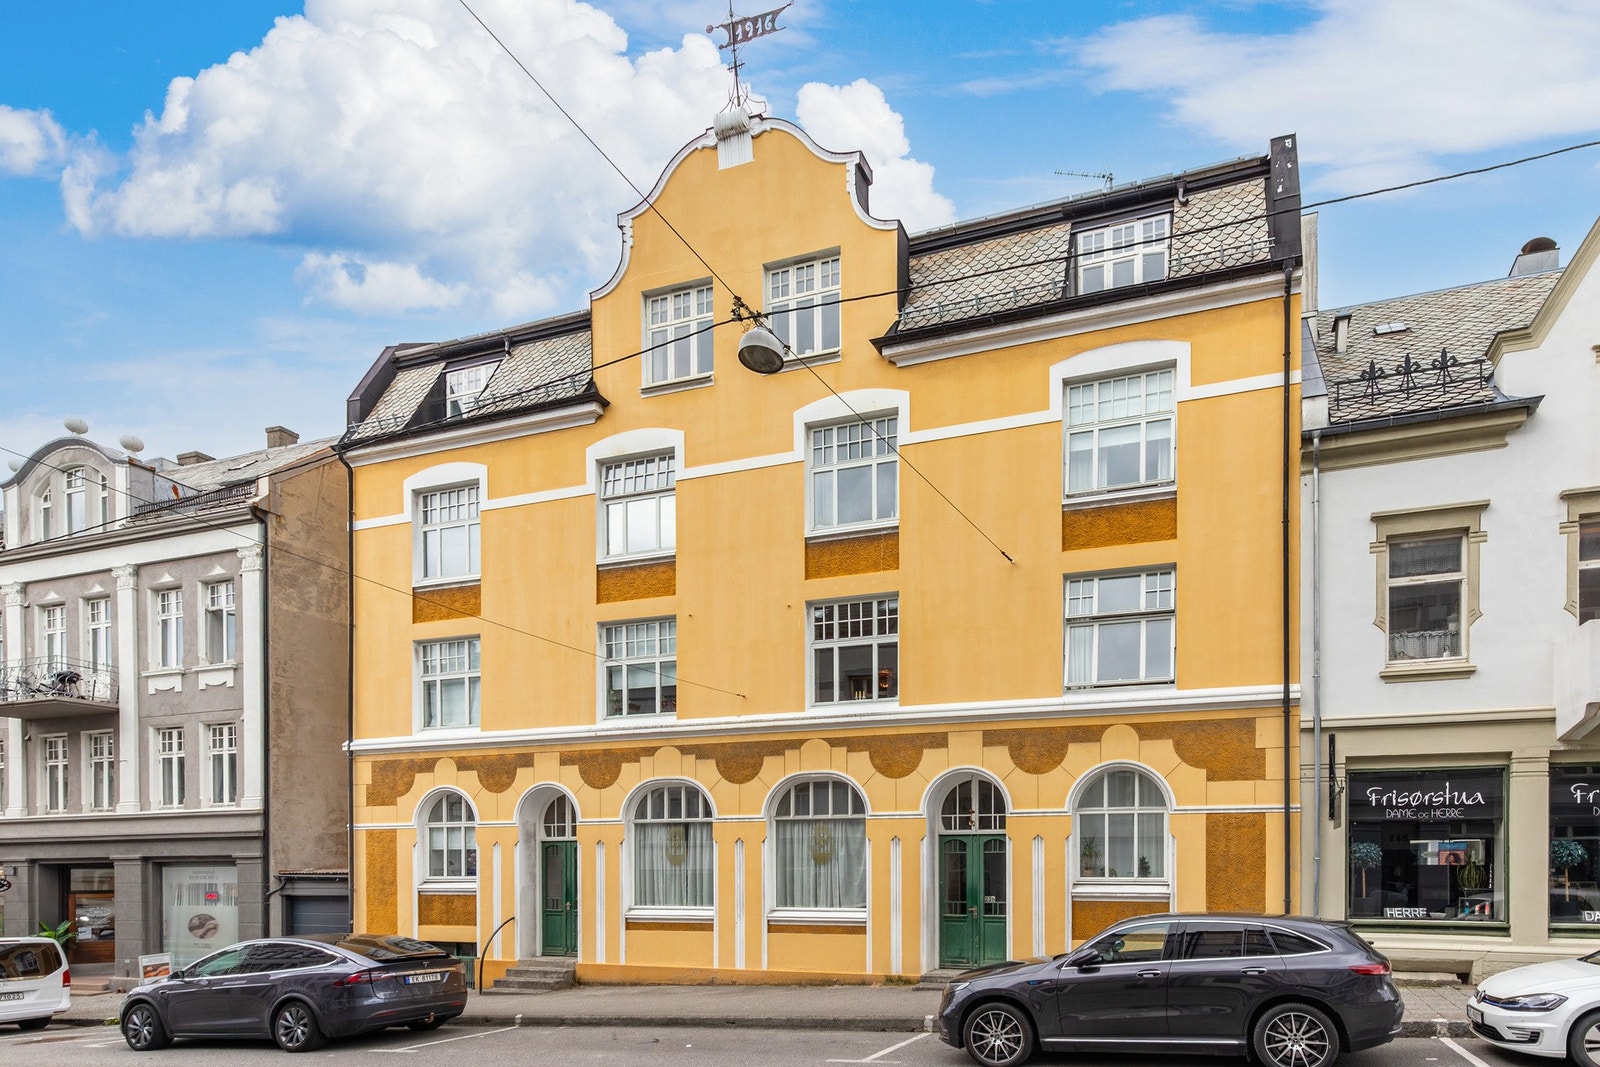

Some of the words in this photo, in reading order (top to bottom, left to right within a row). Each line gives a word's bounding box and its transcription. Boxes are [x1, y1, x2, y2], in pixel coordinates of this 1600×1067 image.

[736, 14, 773, 41] 1916
[1366, 781, 1485, 806] Frisørstua
[1386, 808, 1417, 819] DAME
[1430, 807, 1465, 819] HERRE
